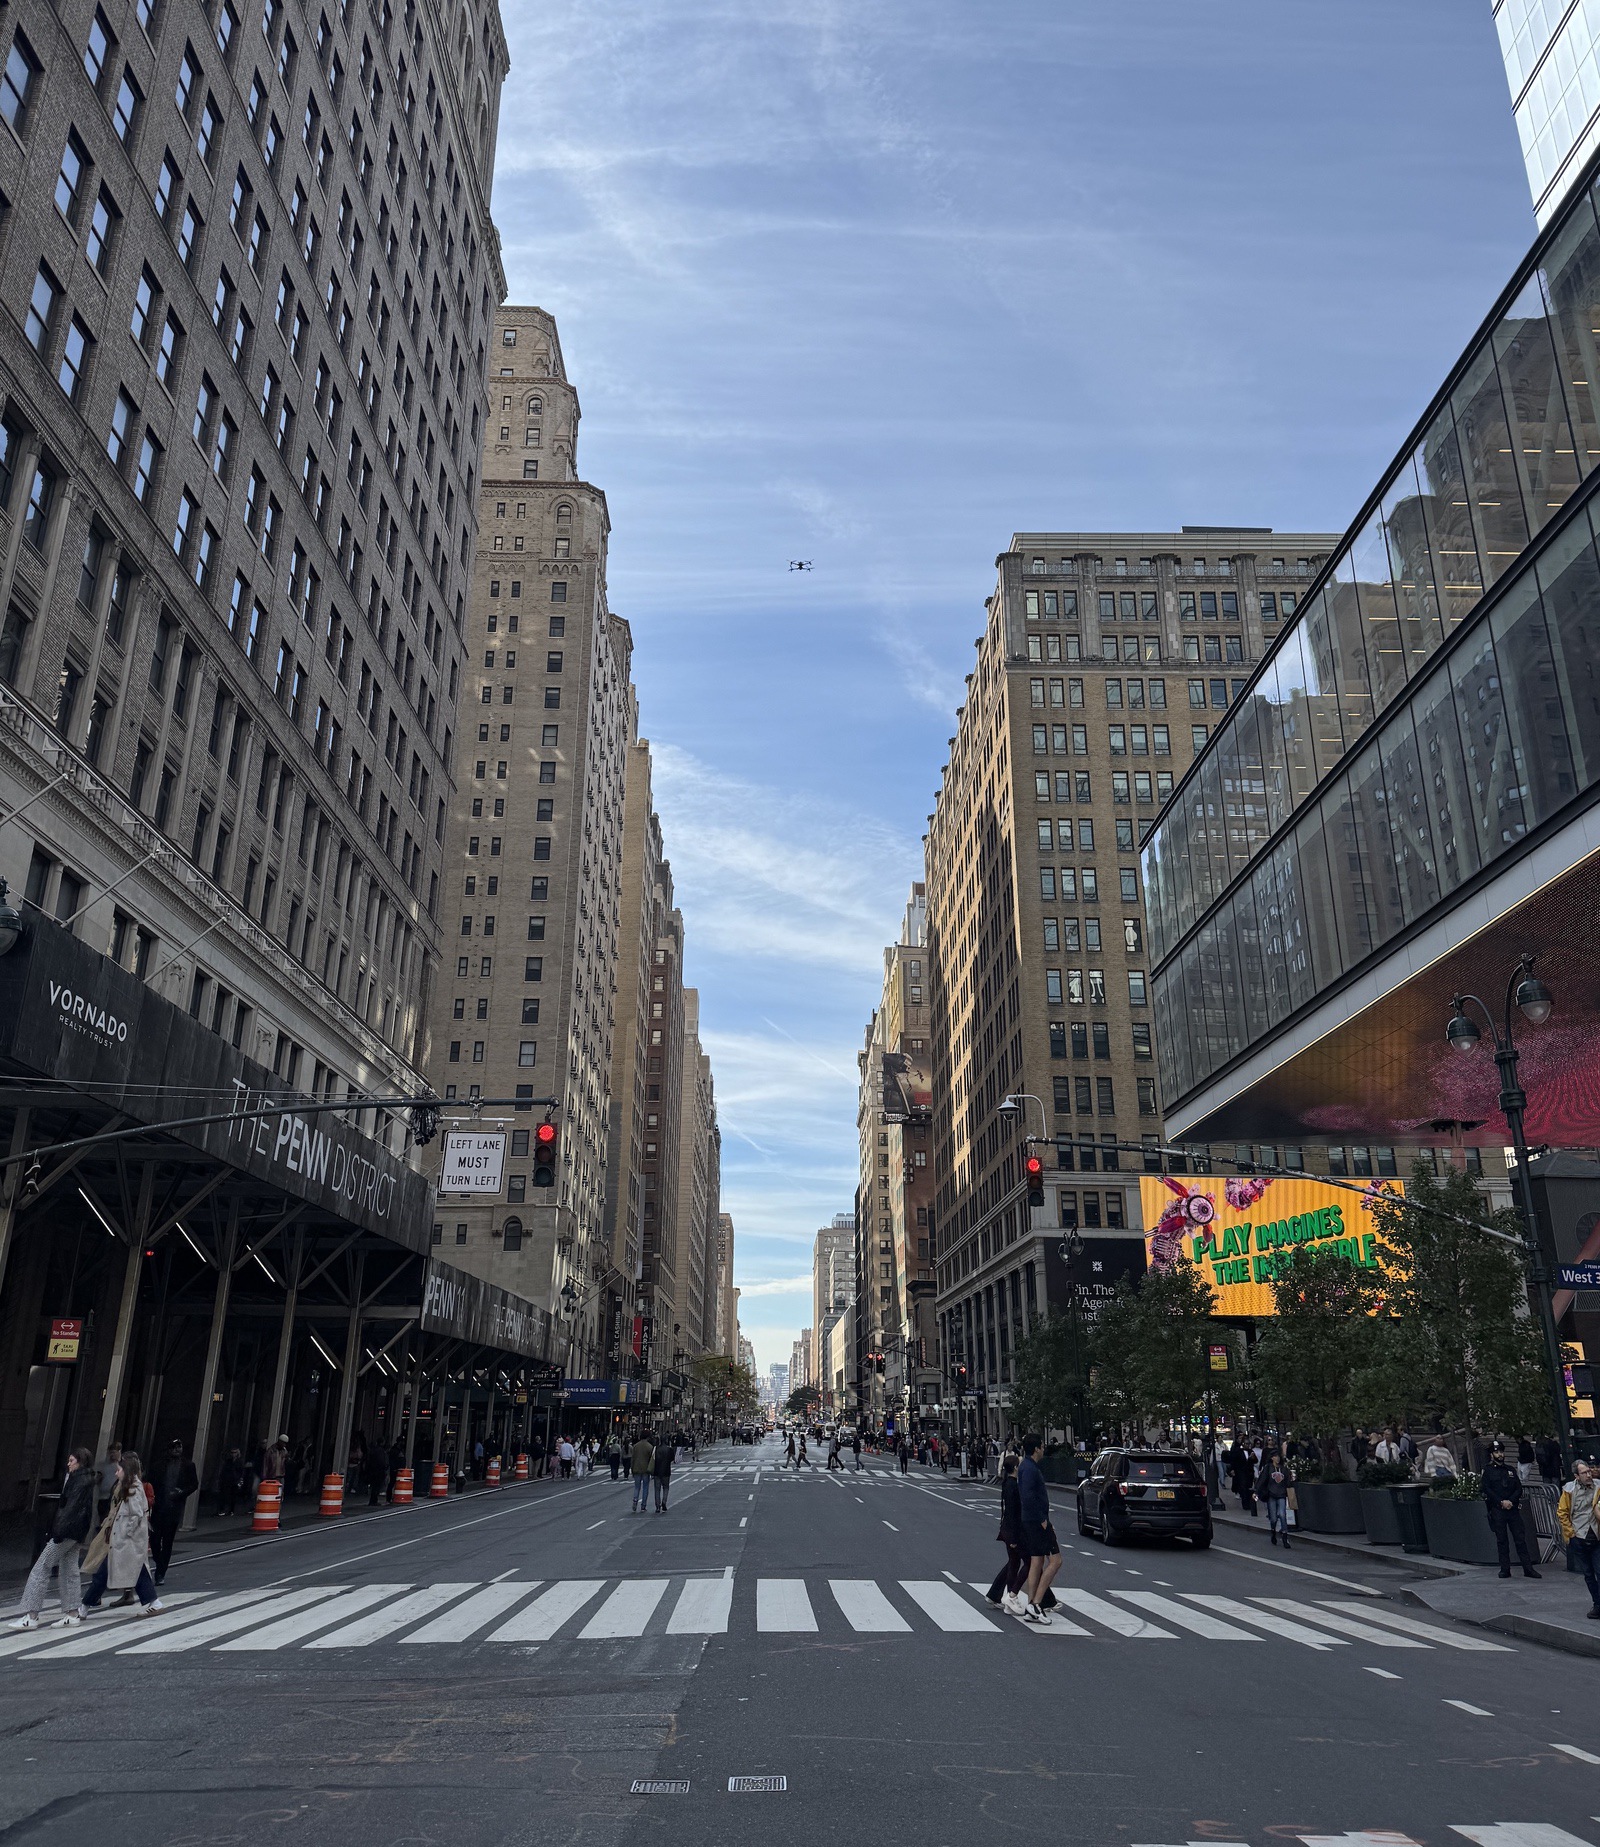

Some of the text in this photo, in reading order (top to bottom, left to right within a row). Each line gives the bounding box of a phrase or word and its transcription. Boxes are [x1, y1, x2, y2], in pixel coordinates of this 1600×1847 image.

[49, 980, 127, 1042] VORNADO
[59, 1014, 113, 1049] REALTY TRUST
[228, 1077, 397, 1219] THE PENN DISTRICT
[450, 1140, 501, 1150] LEFT LANE
[457, 1156, 489, 1169] MUST
[446, 1175, 497, 1186] TURN LEFT
[1193, 1205, 1345, 1264] PLAY IMAGINES
[1212, 1258, 1251, 1285] THE
[1561, 1269, 1593, 1284] West
[424, 1274, 456, 1321] PENN
[1092, 1284, 1115, 1295] The
[612, 1341, 620, 1362] CHECK
